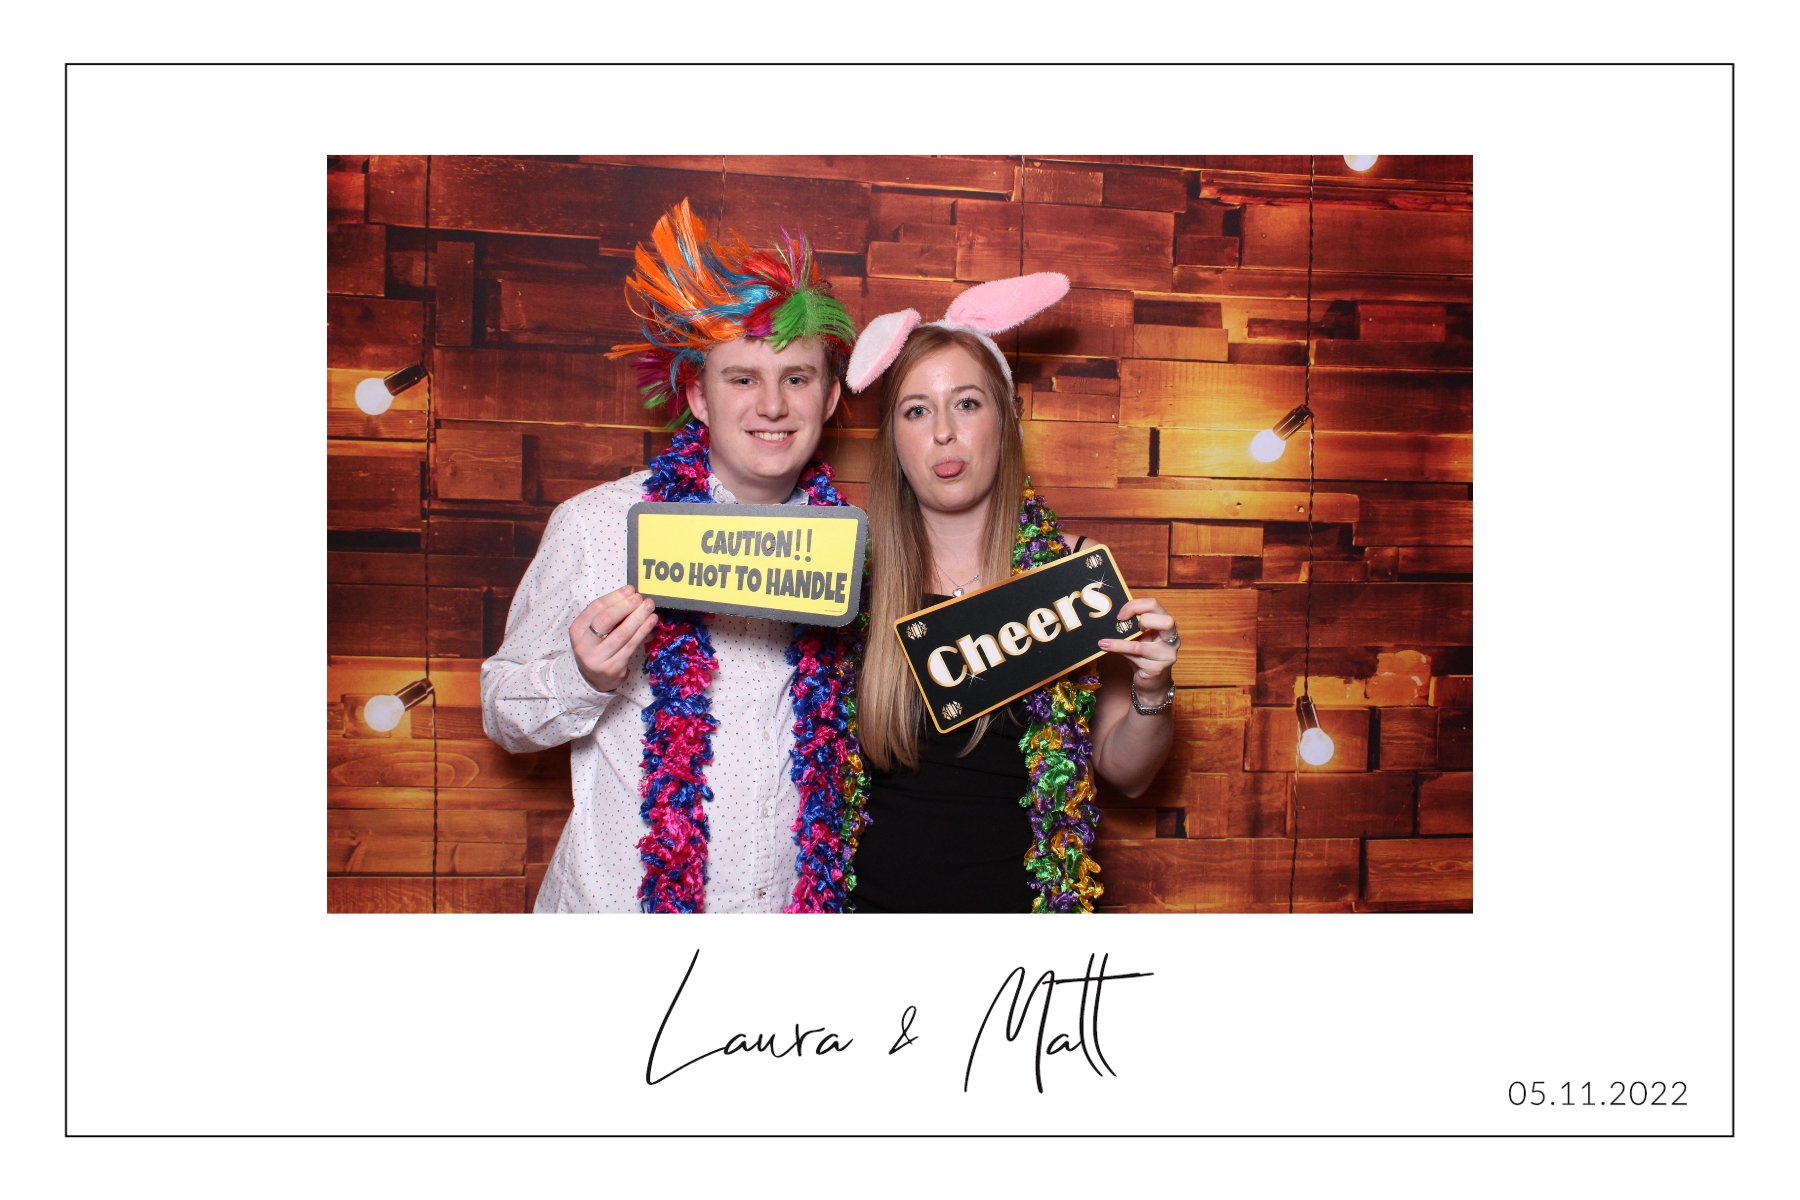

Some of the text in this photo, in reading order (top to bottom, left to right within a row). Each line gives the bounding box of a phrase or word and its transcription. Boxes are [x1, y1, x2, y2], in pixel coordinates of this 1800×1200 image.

[701, 529, 812, 562] CAUTION!!
[643, 558, 848, 603] TOO HOT TO HANDLE
[927, 581, 1113, 688] Cheers
